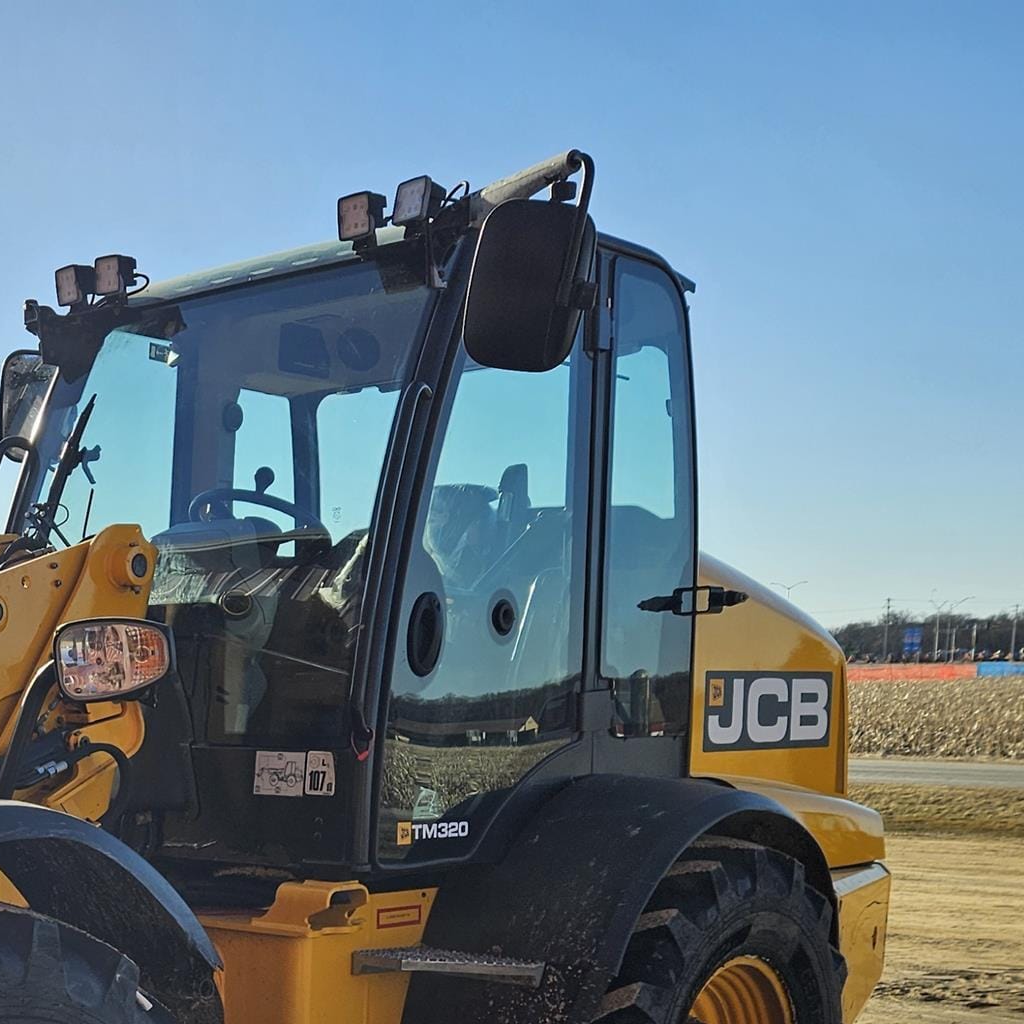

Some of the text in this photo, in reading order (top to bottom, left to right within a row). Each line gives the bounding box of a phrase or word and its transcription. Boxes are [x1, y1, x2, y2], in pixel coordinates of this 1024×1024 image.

[708, 677, 829, 745] JCB
[309, 770, 327, 792] 107
[411, 821, 469, 840] TM320
